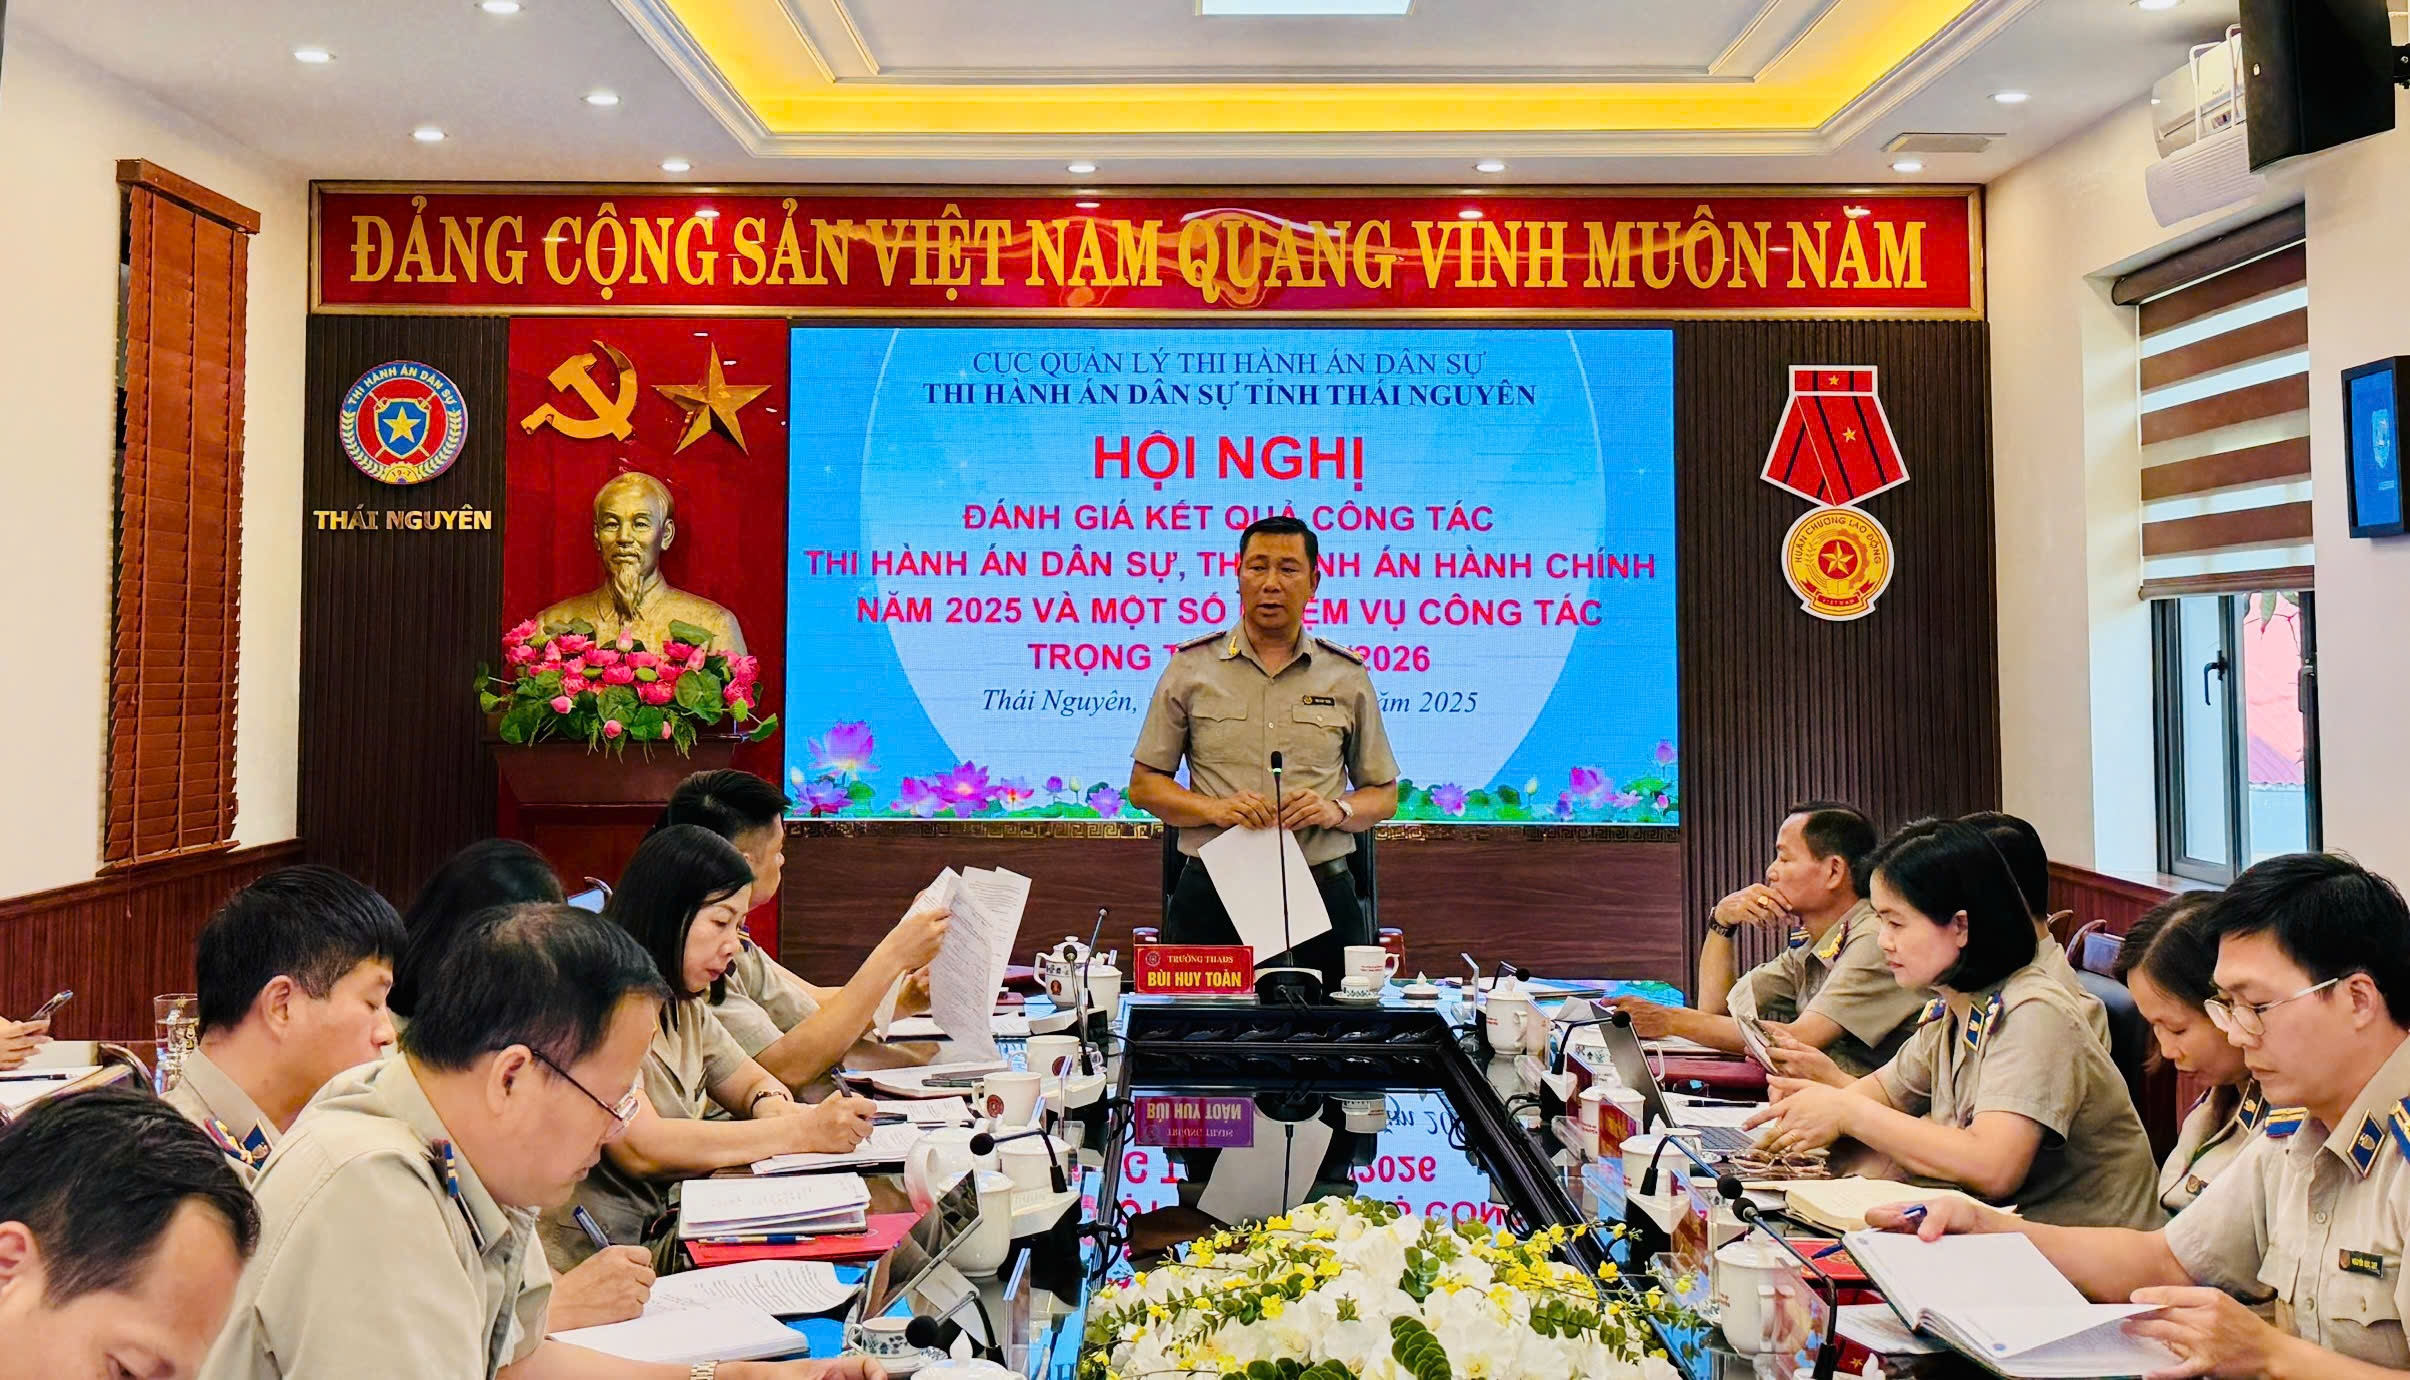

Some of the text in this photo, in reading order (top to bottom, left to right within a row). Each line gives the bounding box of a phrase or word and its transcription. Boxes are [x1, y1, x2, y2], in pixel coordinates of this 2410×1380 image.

[350, 195, 1928, 304] ĐẢNG CỘNG SẢN VIỆT NAM QUANG VINH MUÔN NĂM
[972, 346, 1488, 379] CỤC QUẢN LÝ THI HÀNH ÁN DÂN SỰ
[347, 386, 365, 405] THI
[363, 366, 397, 388] HÀNH
[400, 364, 418, 377] ÁN
[923, 378, 1537, 411] THI HÀNH ÁN DÂN SỰ TỈNH THÁI NGUYÊN
[1094, 429, 1363, 492] HỘI NGHỊ
[313, 503, 492, 530] THÁI NGUYÊN
[962, 499, 1060, 530] ĐÁNH
[1074, 499, 1138, 530] GIÁ
[1146, 498, 1213, 530] KẾT
[1312, 499, 1415, 531] CÔNG
[1426, 499, 1494, 531] TÁC
[804, 550, 857, 576] THI
[871, 542, 967, 576] HÀNH
[980, 542, 1027, 576] ÁN
[1041, 543, 1112, 576] DÂN
[1126, 551, 1186, 583] SỰ,
[1197, 552, 1241, 577] TH
[1373, 544, 1420, 578] ÁN
[1435, 544, 1532, 578] HÀNH
[1546, 546, 1655, 579] CHÍNH
[857, 590, 932, 623] NĂM
[945, 597, 1022, 624] 2025
[1032, 590, 1080, 624] VÀ
[1091, 592, 1168, 631] MỘT
[1178, 591, 1226, 625] SỐ
[1360, 599, 1406, 632] VỤ
[1419, 592, 1522, 626] CÔNG
[1533, 592, 1603, 626] TÁC
[1027, 643, 1151, 677] TRỌNG
[983, 688, 1479, 717] Thái Nguyên, ăm 2025
[1147, 968, 1242, 987] BÙI HUY TOÀN
